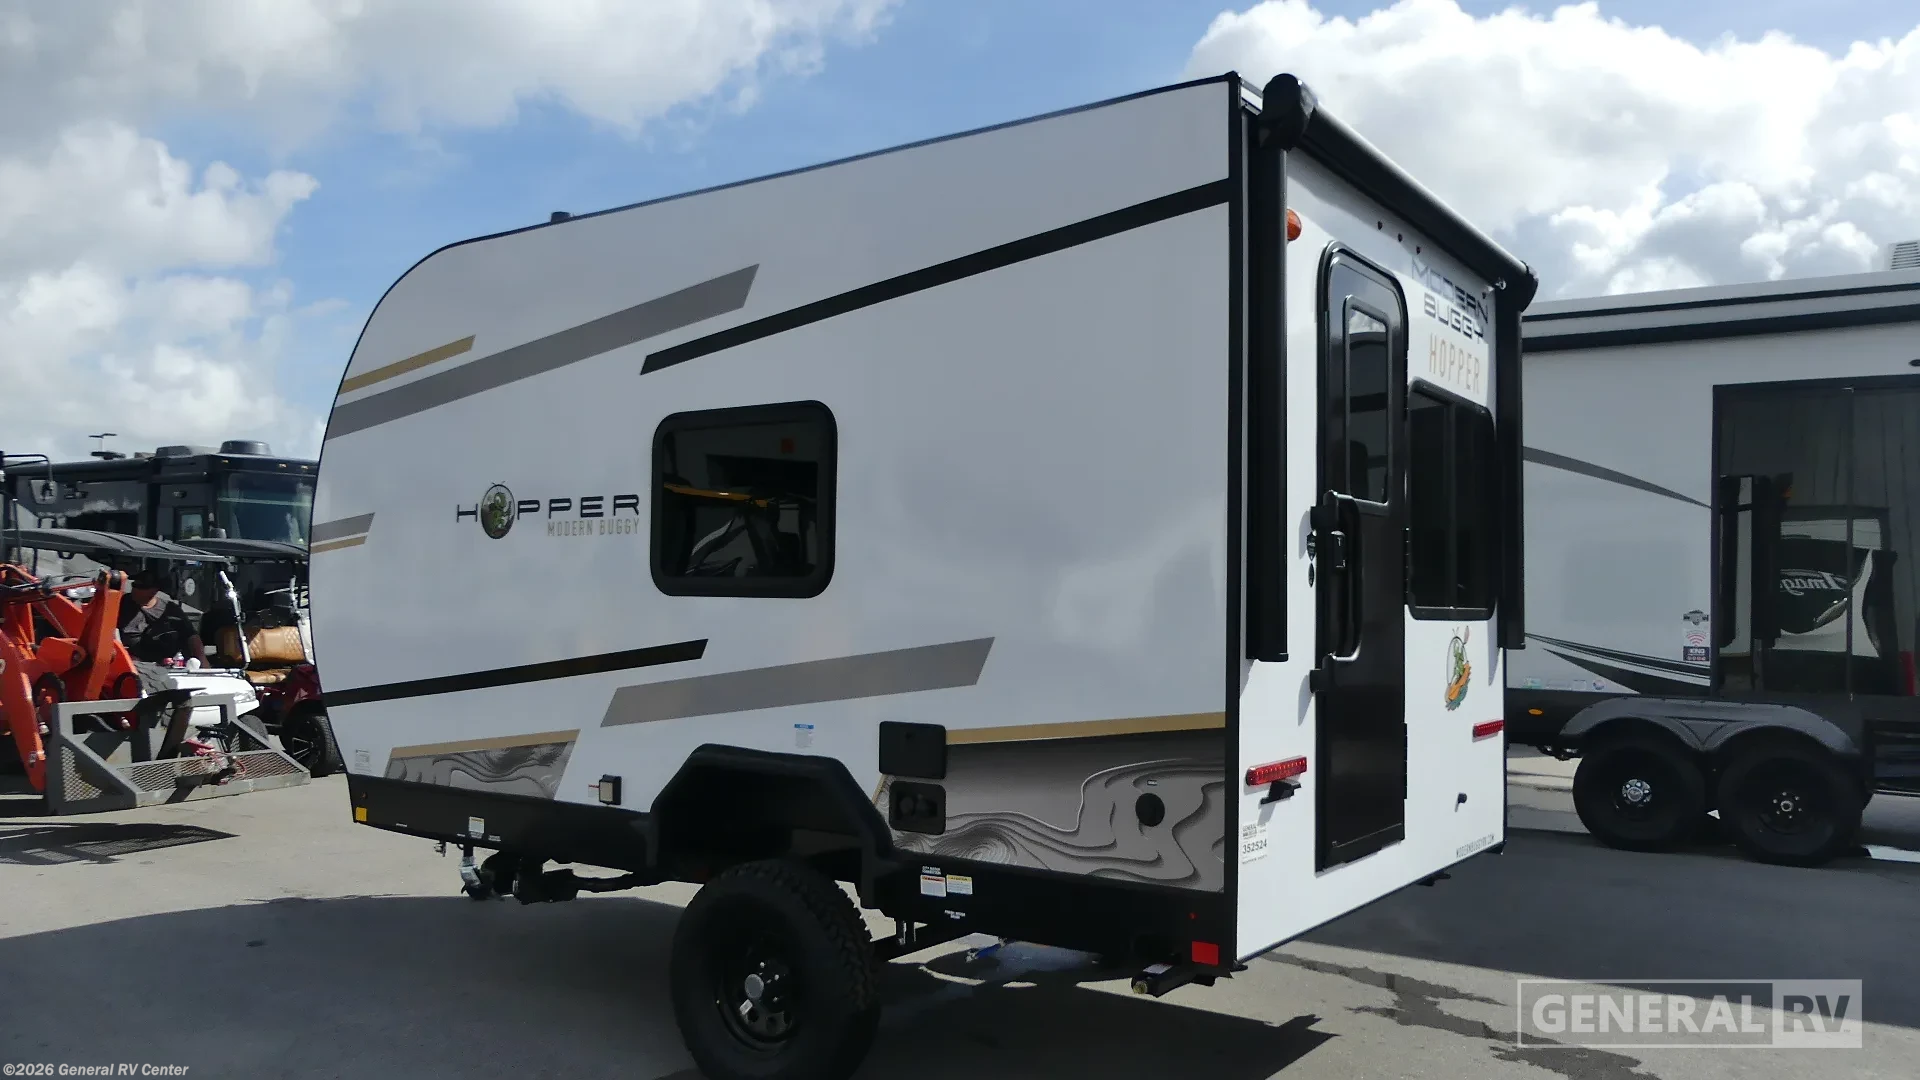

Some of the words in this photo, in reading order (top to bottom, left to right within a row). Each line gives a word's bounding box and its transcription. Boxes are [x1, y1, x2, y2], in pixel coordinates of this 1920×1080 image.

[1411, 256, 1489, 324] MODERN
[1424, 292, 1484, 345] BUGGY
[1429, 332, 1481, 394] HOPPER
[548, 519, 593, 537] MODERN
[600, 518, 640, 536] BUGGY
[1242, 838, 1268, 854] 352524
